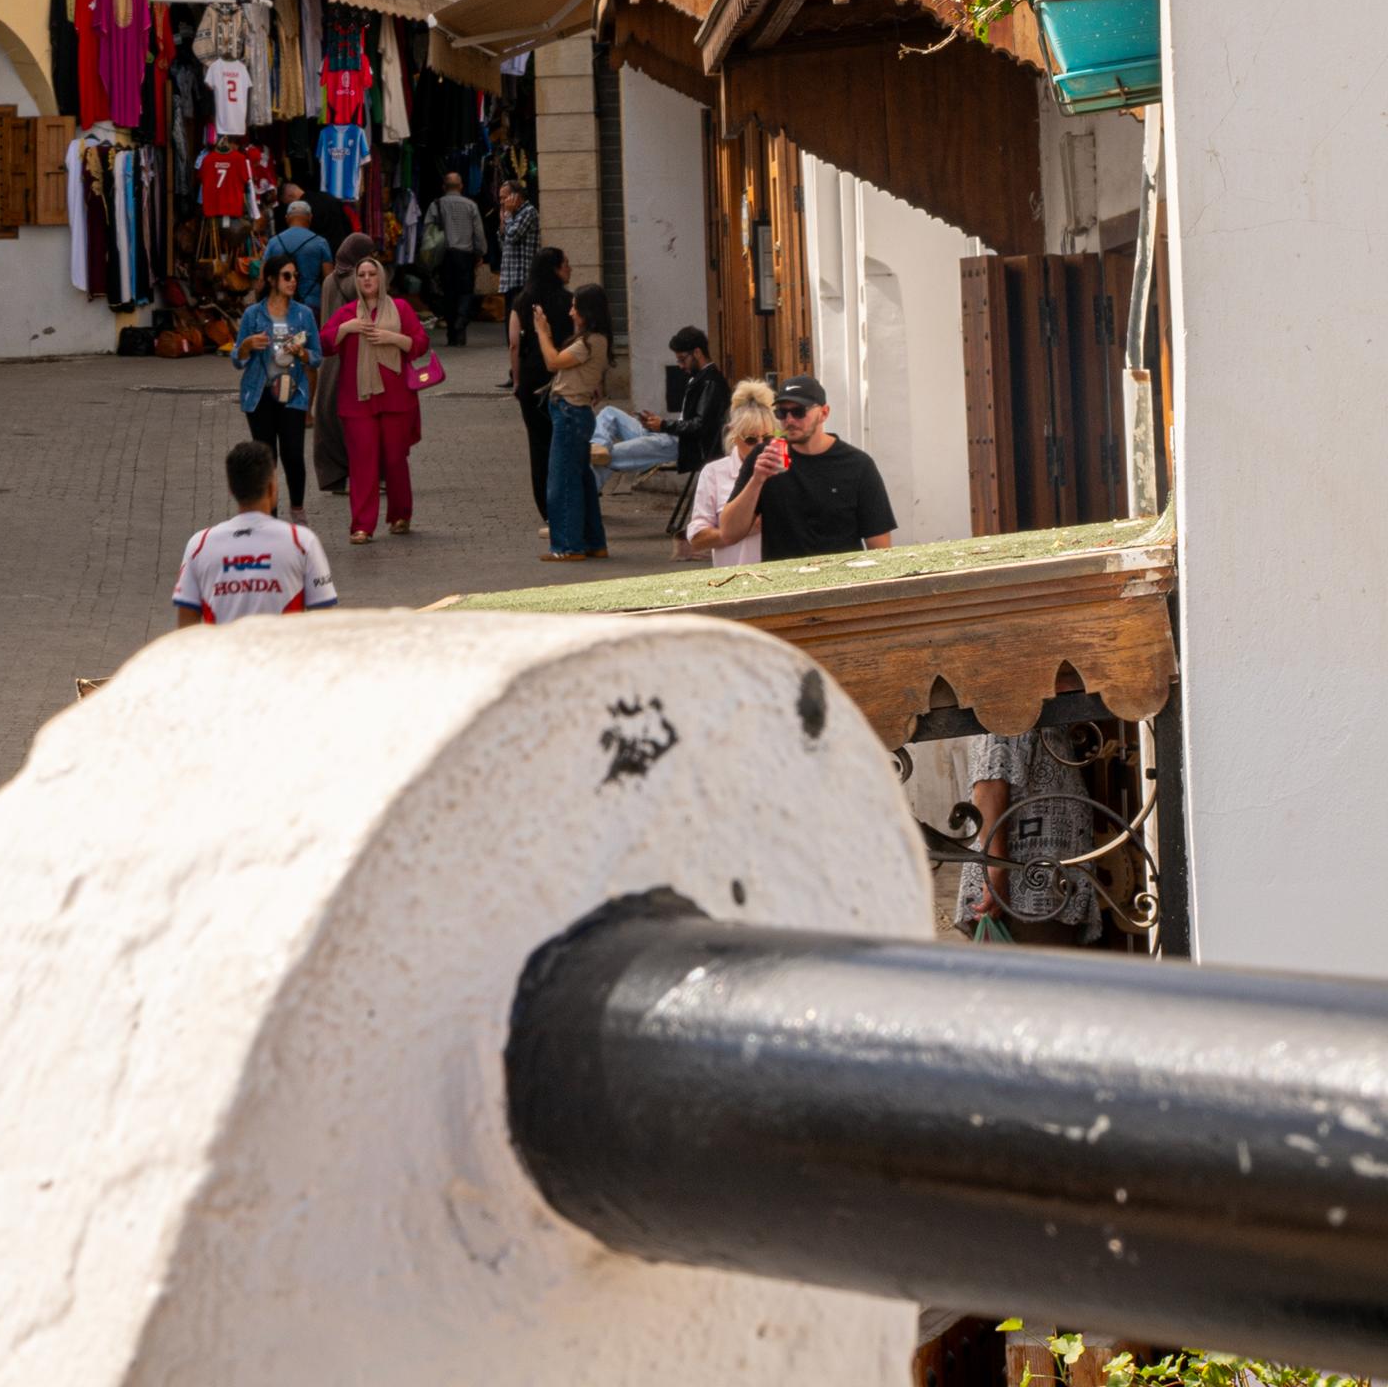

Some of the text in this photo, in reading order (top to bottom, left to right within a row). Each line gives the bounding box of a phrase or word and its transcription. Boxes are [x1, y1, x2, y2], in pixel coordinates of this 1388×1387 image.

[227, 80, 237, 102] 2
[217, 169, 227, 188] 7
[222, 553, 272, 573] HRC
[213, 578, 283, 596] HONDA
